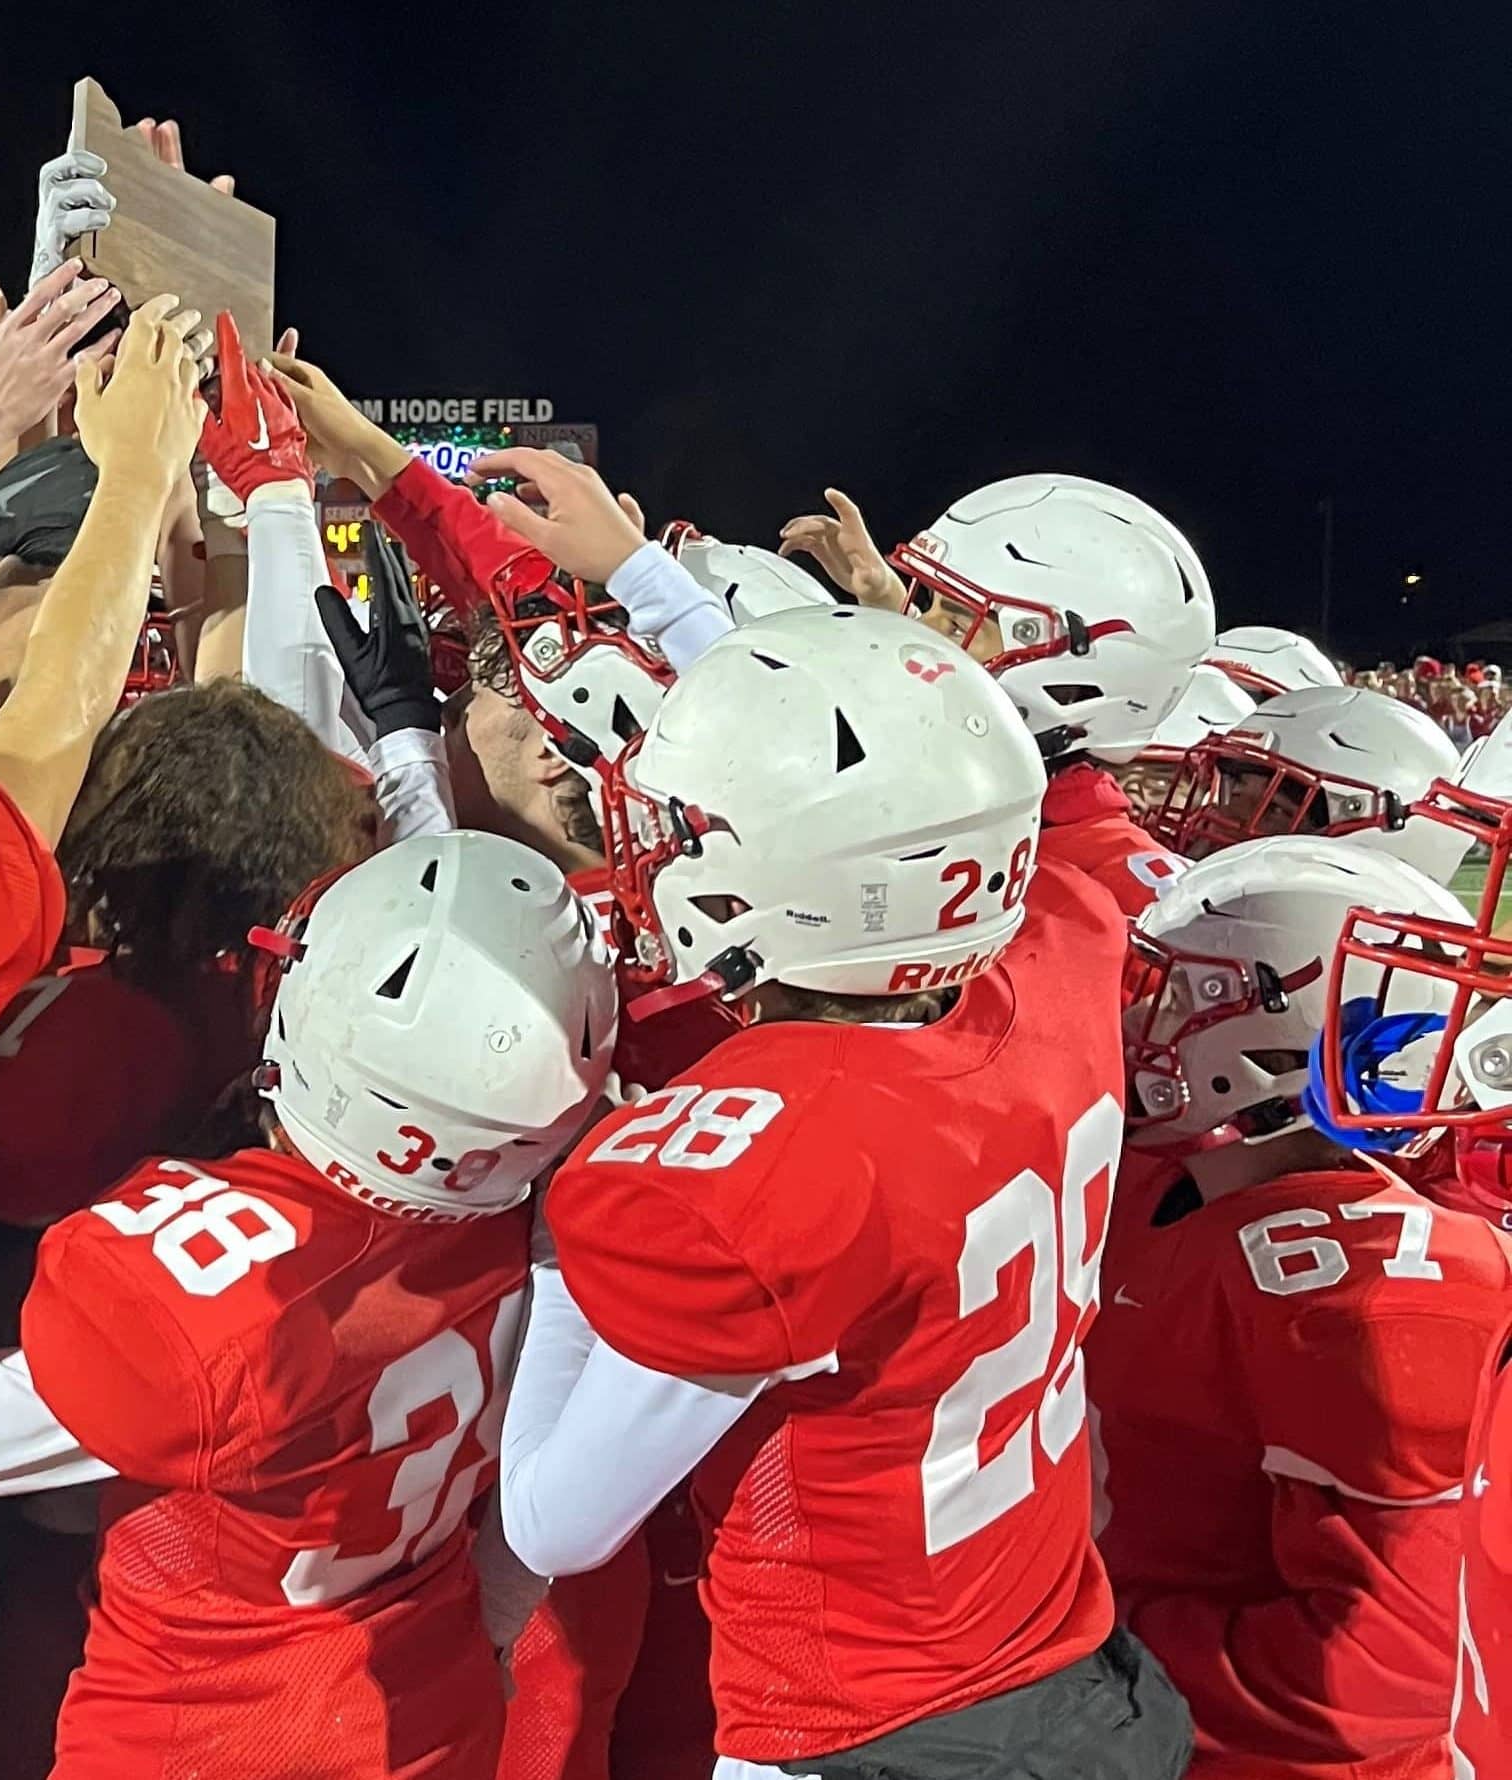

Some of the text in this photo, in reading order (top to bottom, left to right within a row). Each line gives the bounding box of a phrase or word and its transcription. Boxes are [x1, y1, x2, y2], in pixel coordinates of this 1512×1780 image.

[390, 399, 477, 423] HODGE
[483, 399, 553, 423] FIELD
[938, 837, 1031, 931] 28
[587, 1085, 785, 1171] 28
[90, 1160, 297, 1297] 38
[1239, 1202, 1443, 1297] 67
[921, 1092, 1125, 1556] 28
